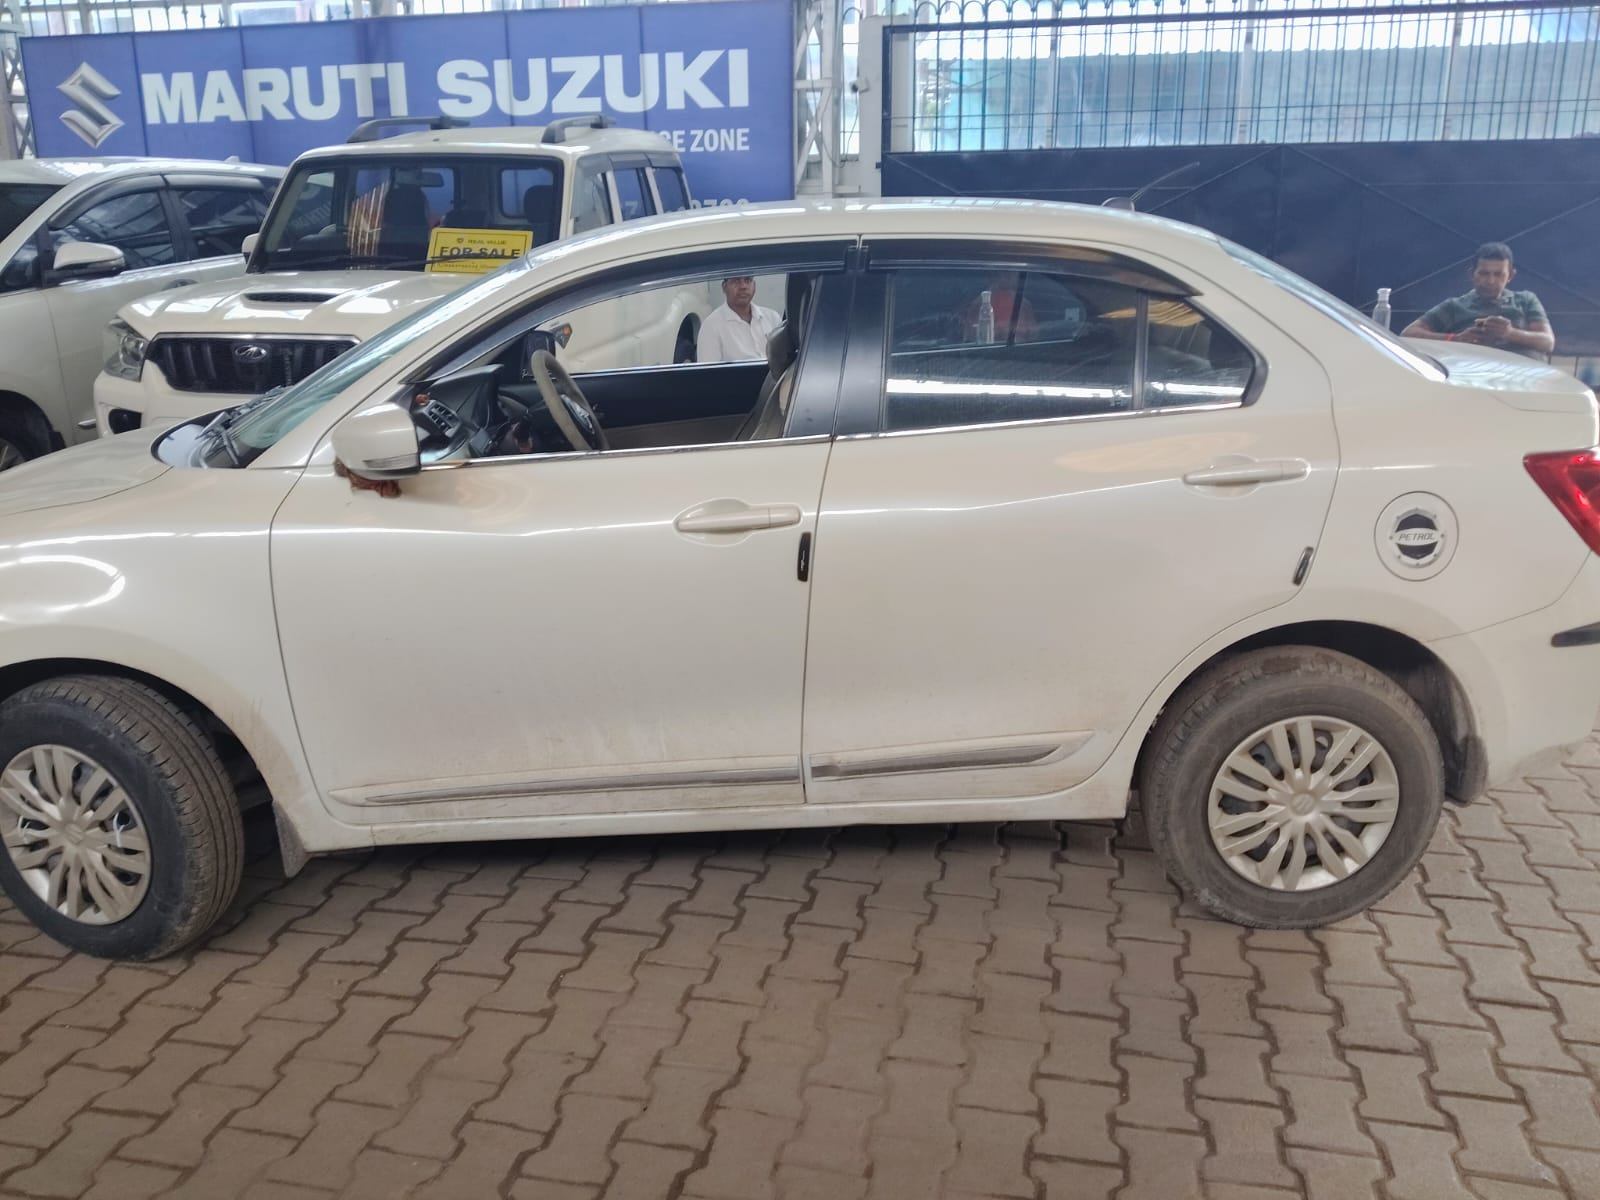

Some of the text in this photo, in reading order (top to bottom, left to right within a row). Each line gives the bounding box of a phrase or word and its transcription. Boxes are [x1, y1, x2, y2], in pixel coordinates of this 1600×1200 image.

[141, 48, 750, 125] MARUTI SUZUKI
[690, 128, 750, 153] ZONE
[440, 246, 521, 259] FOR SALE
[1398, 532, 1435, 541] PETROL
